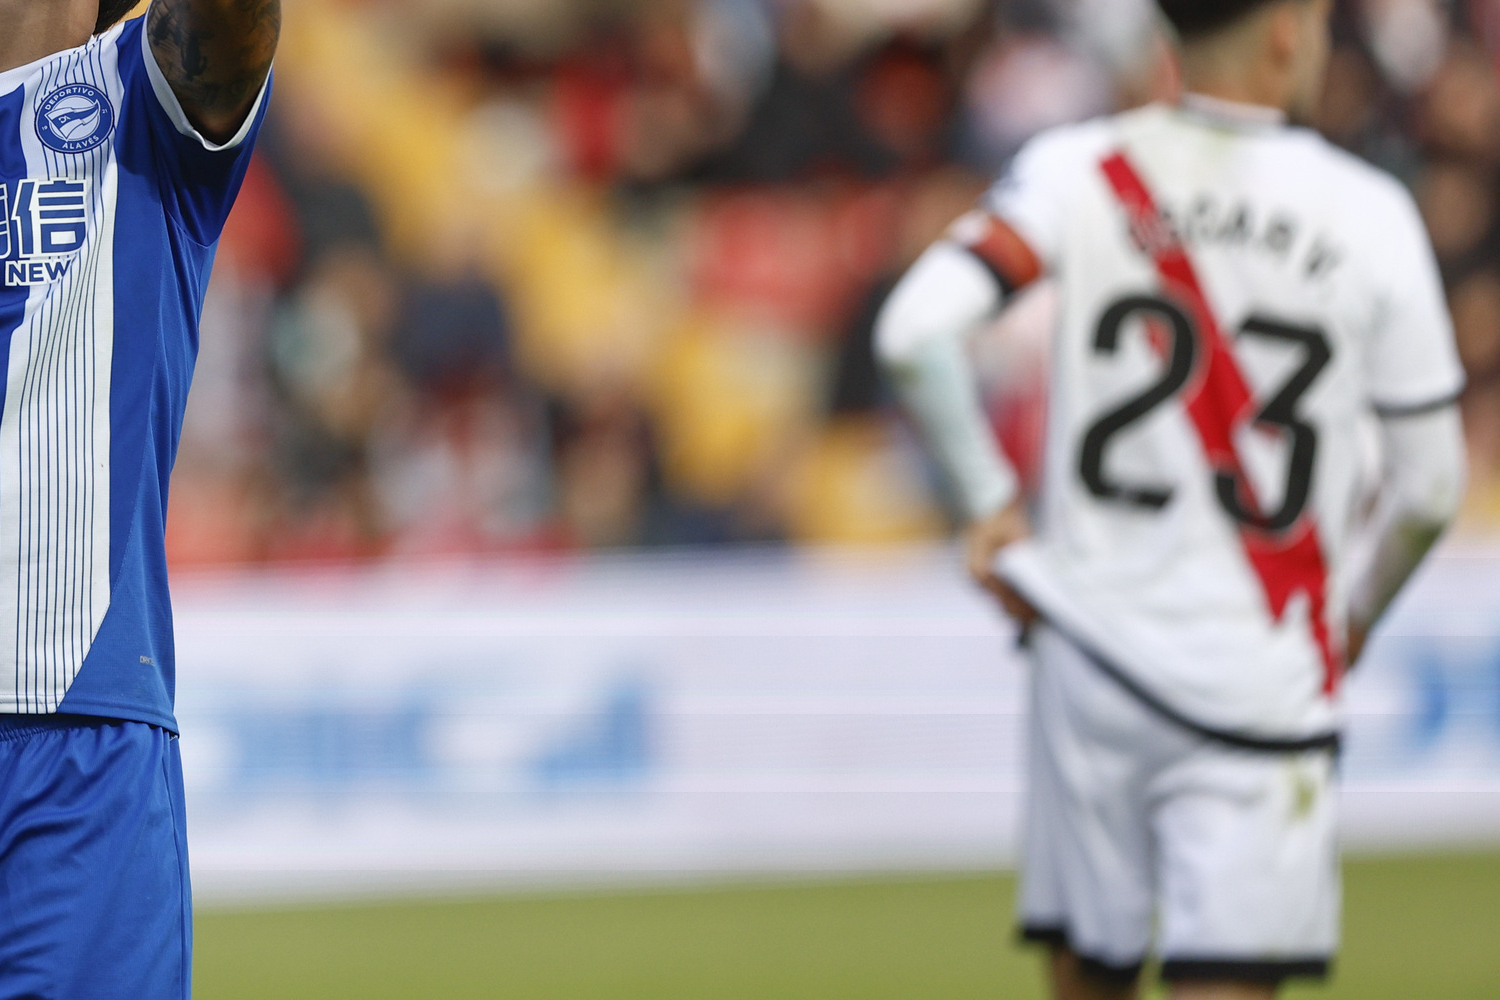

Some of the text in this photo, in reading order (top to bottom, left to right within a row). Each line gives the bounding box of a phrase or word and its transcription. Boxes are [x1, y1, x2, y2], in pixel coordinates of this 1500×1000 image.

[44, 87, 95, 110] DEPORTIVO
[62, 135, 100, 149] ALAVÉS
[5, 259, 72, 286] NEW
[1074, 292, 1334, 534] 23
